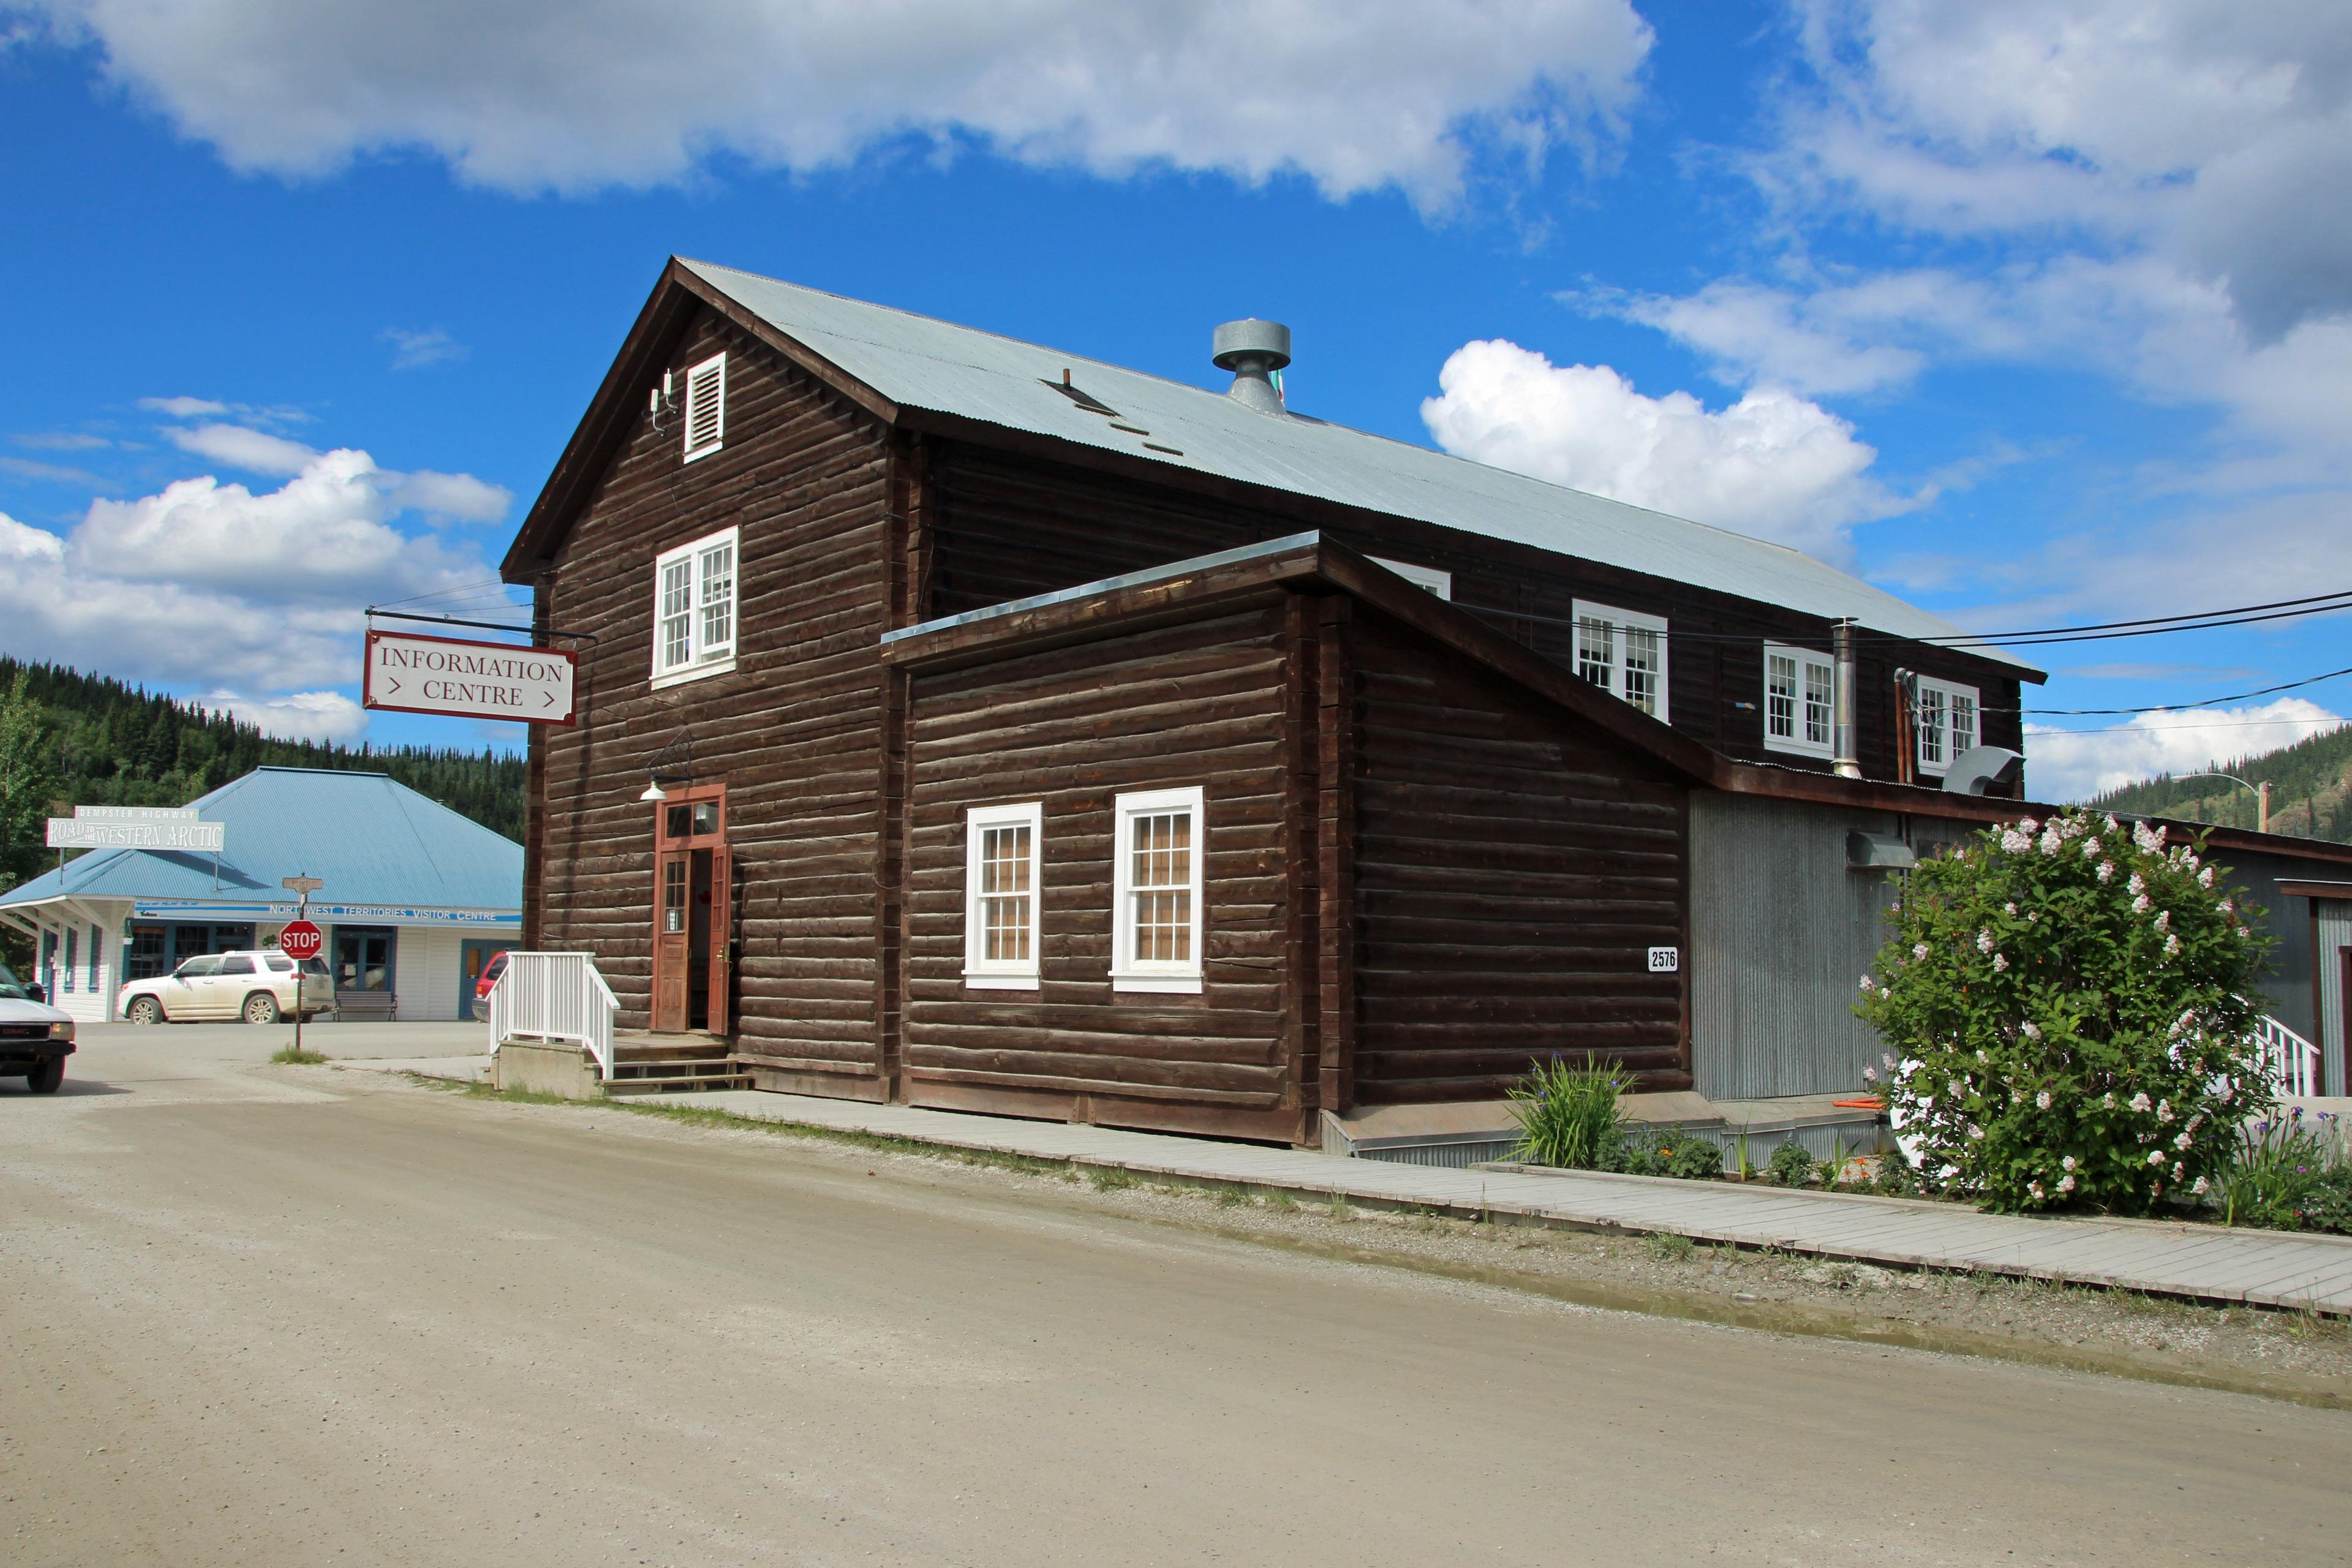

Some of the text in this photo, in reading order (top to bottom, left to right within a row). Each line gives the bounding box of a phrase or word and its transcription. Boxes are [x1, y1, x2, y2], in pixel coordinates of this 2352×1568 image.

[381, 647, 563, 682] INFORMATION
[424, 680, 522, 706] CENTRE
[80, 808, 195, 819] DEMPSTER HIGHWAY
[50, 821, 85, 843] ROAD
[85, 832, 96, 841] THE
[97, 826, 161, 846] WESTERN
[166, 826, 221, 847] ARCTIC
[342, 906, 407, 918] TERRITORIES
[413, 908, 450, 919] VISITOR
[457, 910, 497, 921] CENTRE
[283, 932, 320, 948] STOP
[1653, 951, 1675, 967] 2576
